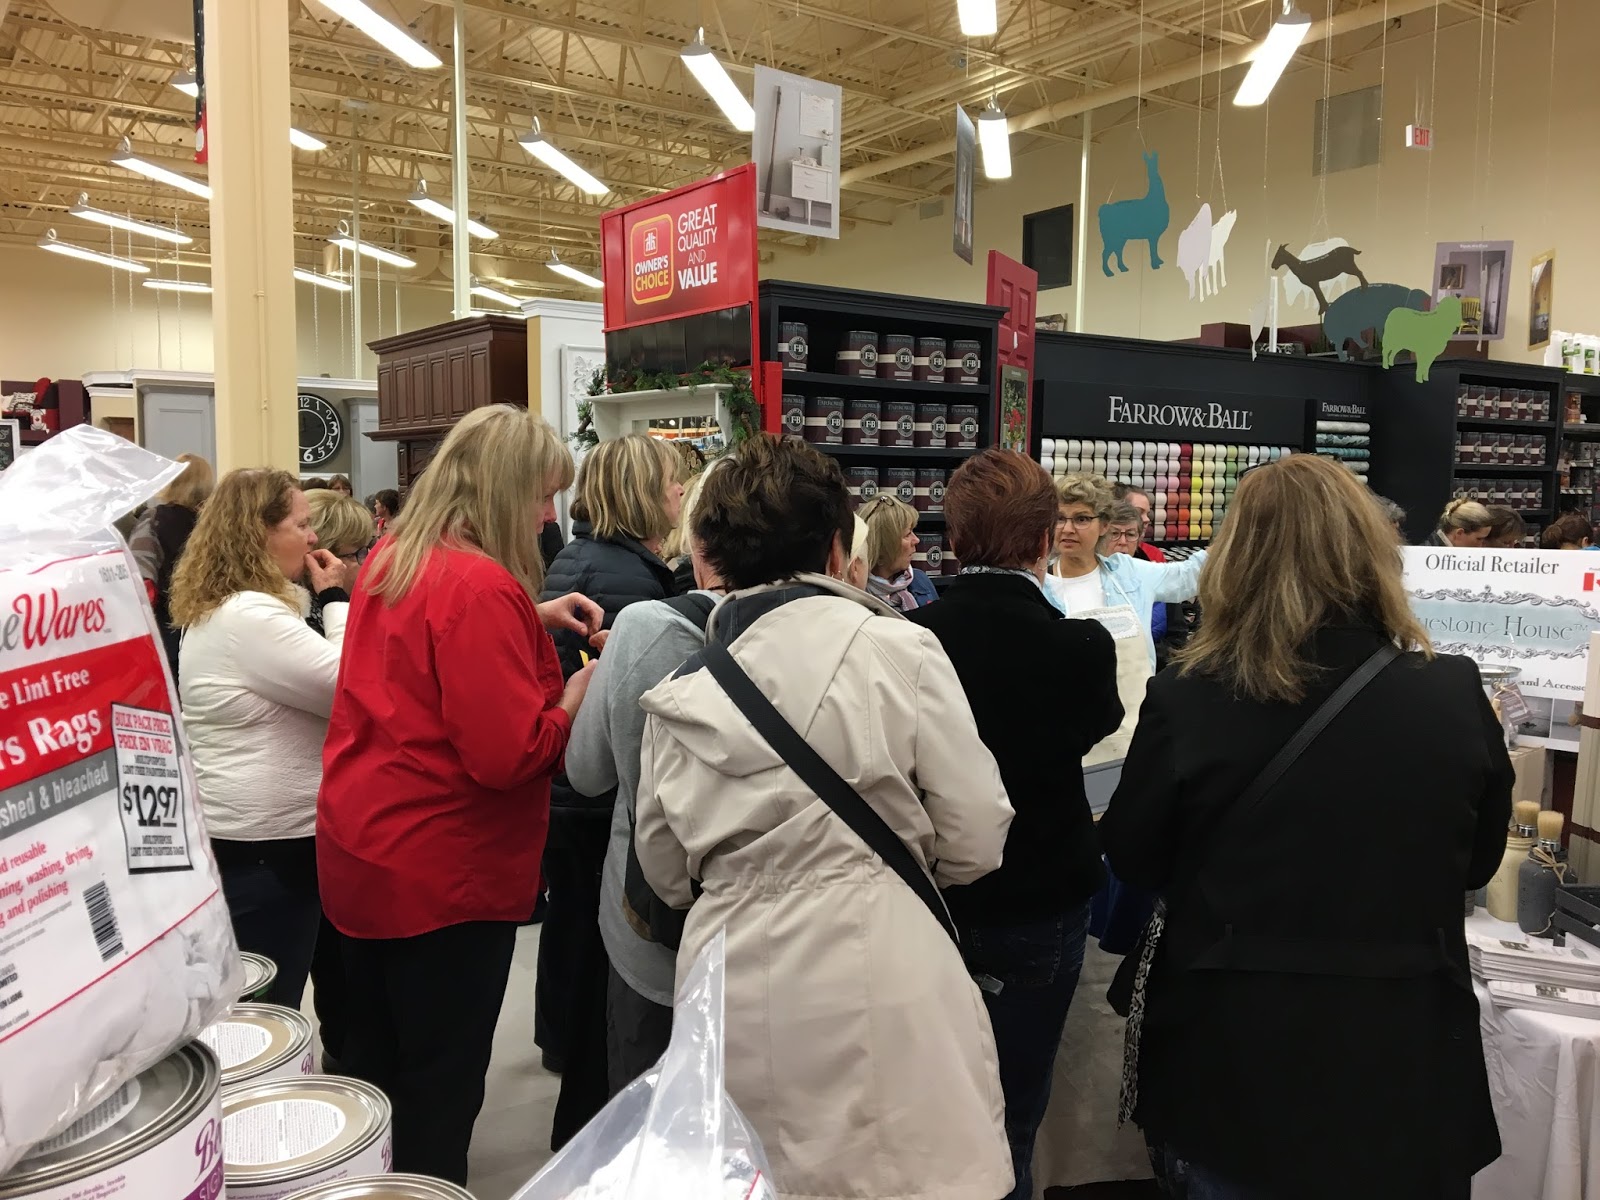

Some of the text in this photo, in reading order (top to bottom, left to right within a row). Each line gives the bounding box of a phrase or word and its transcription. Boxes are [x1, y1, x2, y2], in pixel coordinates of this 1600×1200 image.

[1415, 127, 1430, 147] EXIT
[677, 203, 718, 234] GREAT
[677, 227, 718, 252] QUALITY
[634, 254, 669, 276] OWNER'S
[687, 249, 707, 266] AND
[635, 270, 669, 292] CHOICE
[677, 262, 718, 290] VALUE
[299, 397, 310, 408] 12
[316, 400, 320, 411] 1
[1107, 395, 1253, 431] FARROW&BALL
[325, 409, 332, 420] 2
[327, 421, 338, 436] 3
[317, 446, 325, 459] 5
[326, 435, 334, 449] 4
[303, 448, 314, 462] 6
[1424, 553, 1560, 575] Official Retailer
[11, 673, 51, 706] Lint
[51, 669, 91, 694] Free
[27, 708, 102, 756] Rags
[39, 785, 51, 810] &
[52, 760, 110, 804] bleached
[10, 841, 47, 869] reusable
[7, 898, 26, 920] and
[27, 880, 69, 914] polishing
